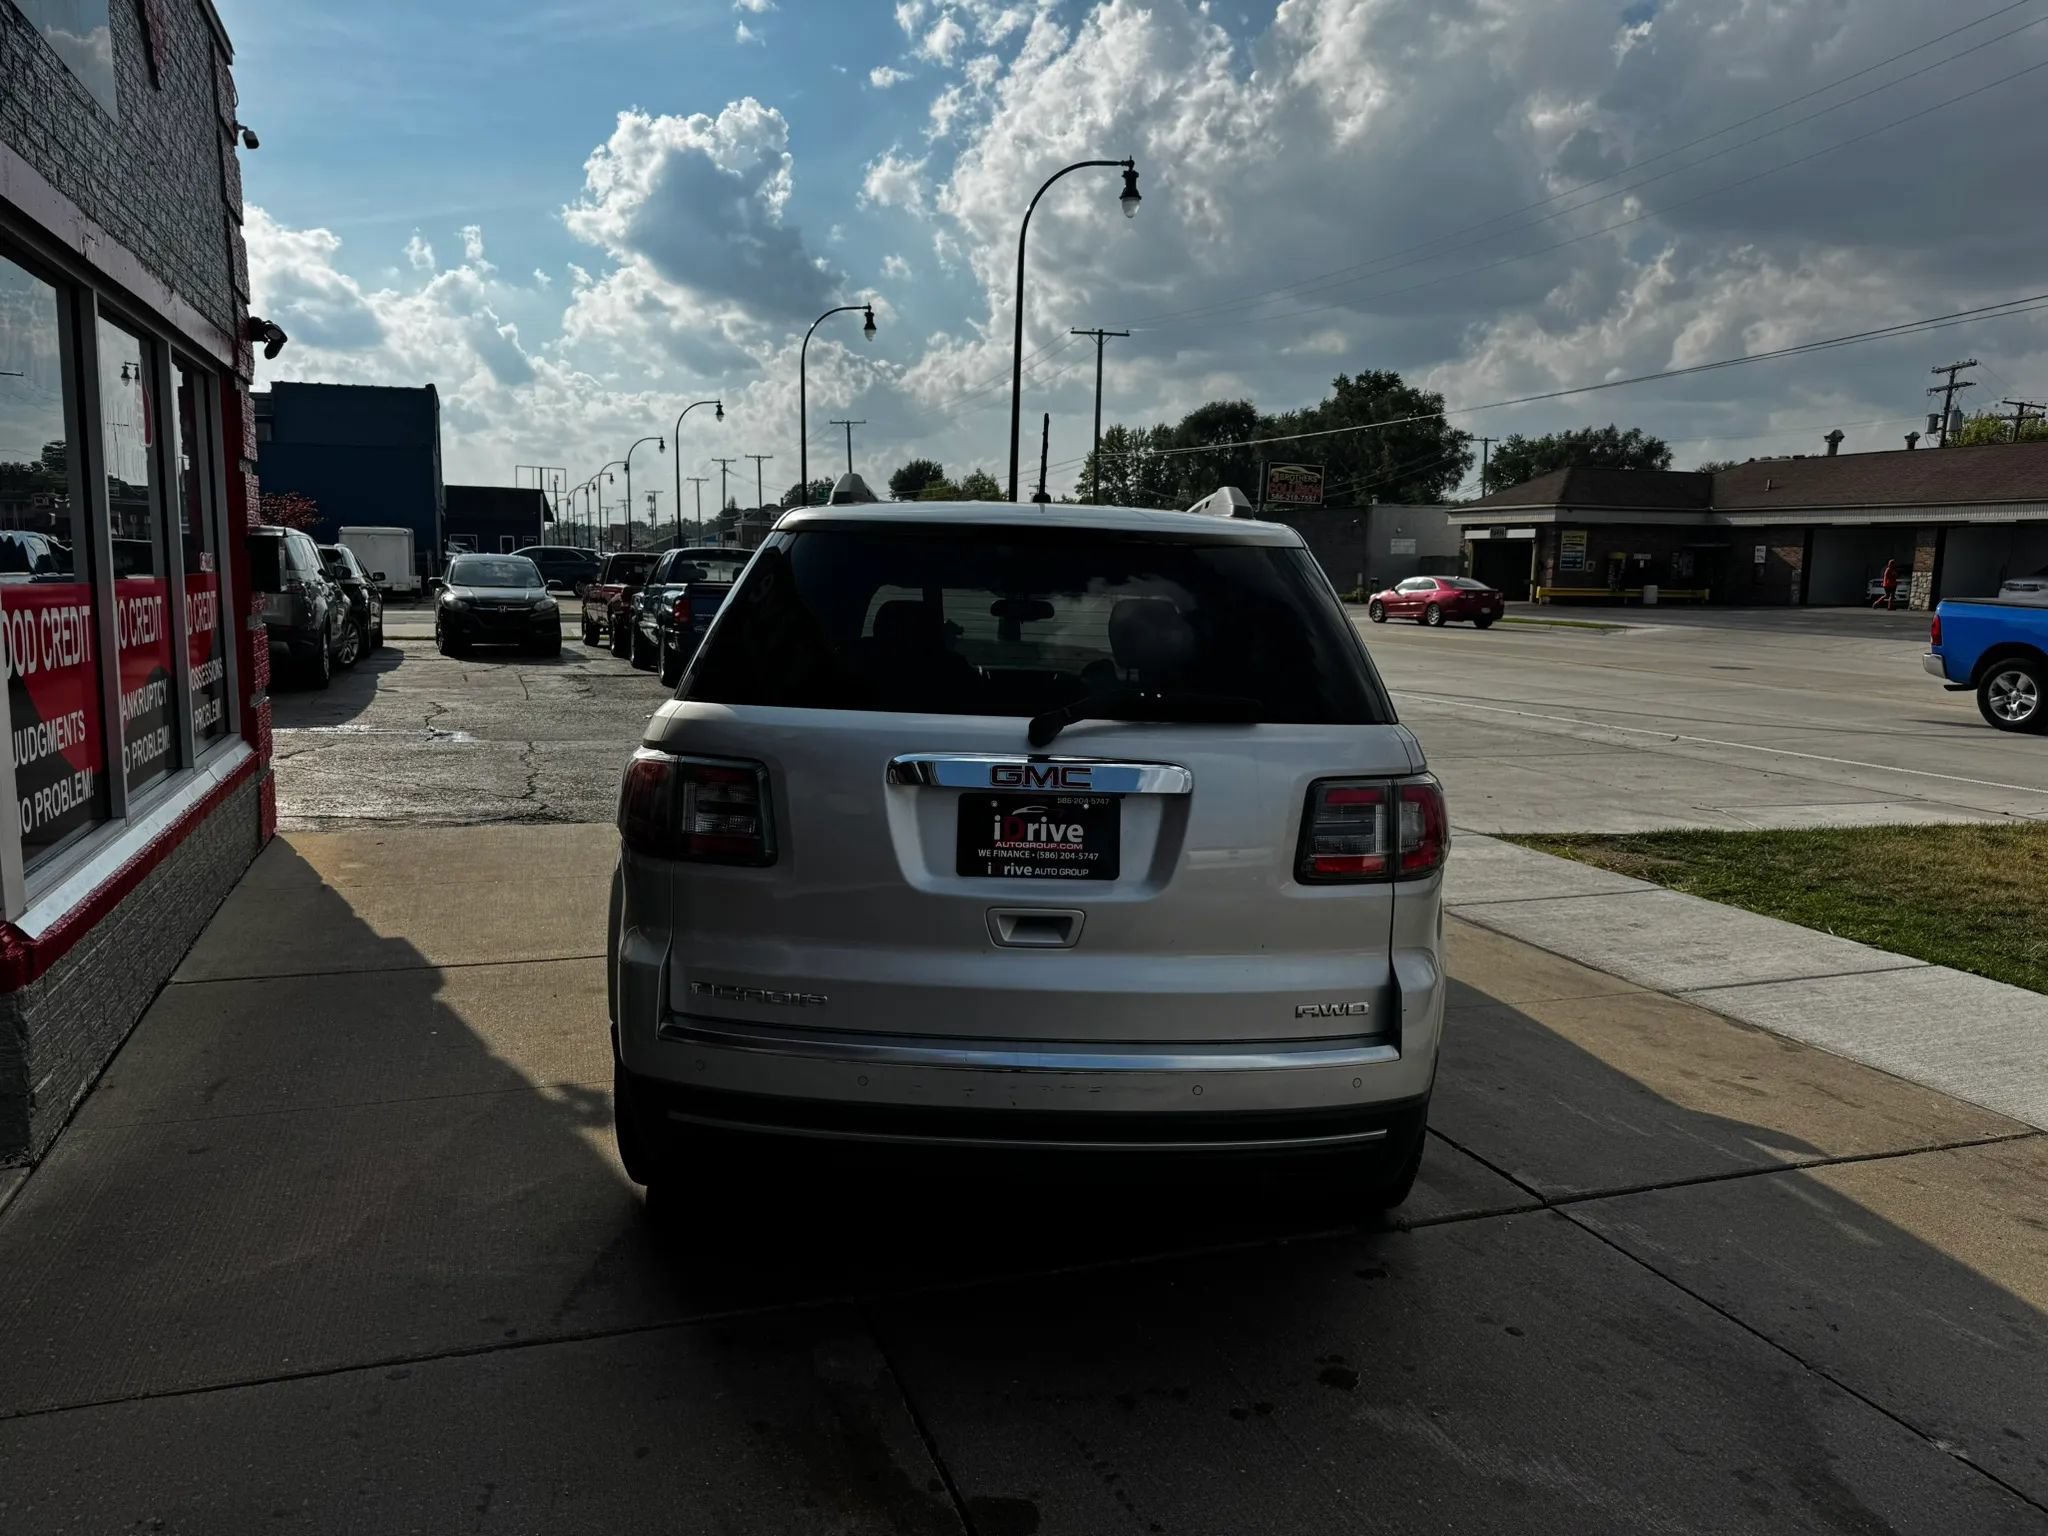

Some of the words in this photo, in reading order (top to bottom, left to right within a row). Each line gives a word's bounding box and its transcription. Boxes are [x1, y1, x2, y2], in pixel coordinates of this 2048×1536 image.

[129, 596, 163, 647] CREDIT
[193, 590, 217, 632] CREDIT
[41, 605, 91, 672] CREDIT
[14, 709, 86, 768] JUDGMENTS
[131, 724, 170, 770] PROBLEM!
[991, 765, 1093, 790] GMC
[35, 765, 95, 827] PROBLEM!
[993, 814, 1084, 843] iDrive
[995, 841, 1083, 850] AUTOGROUP.COM
[978, 849, 992, 858] WE
[993, 850, 1030, 859] FINANCE
[1036, 851, 1058, 861] (586)
[1060, 852, 1099, 861] 204-5747
[1035, 867, 1057, 876] AUTO
[1059, 867, 1089, 877] GROUP
[1295, 1001, 1369, 1018] AWD
